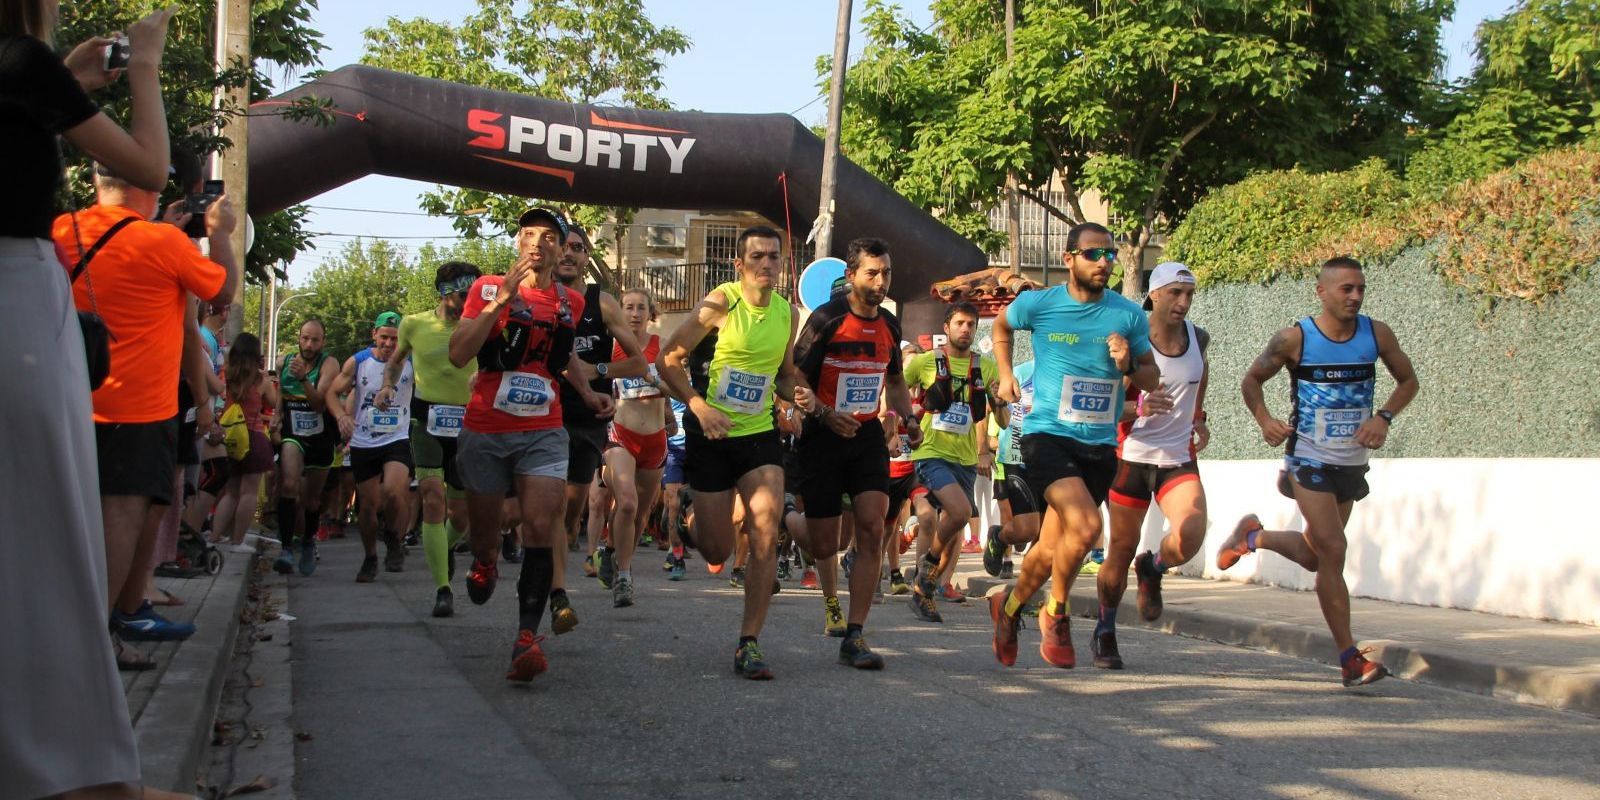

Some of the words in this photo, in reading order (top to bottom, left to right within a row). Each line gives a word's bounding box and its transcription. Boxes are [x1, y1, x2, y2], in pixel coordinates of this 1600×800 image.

[467, 109, 696, 174] SPORTY
[917, 335, 947, 351] SP
[514, 390, 540, 404] 301
[734, 386, 757, 401] 110
[852, 390, 874, 401] 257
[1078, 396, 1105, 410] 137
[440, 417, 459, 427] 159
[943, 412, 963, 423] 233
[1331, 424, 1356, 435] 260
